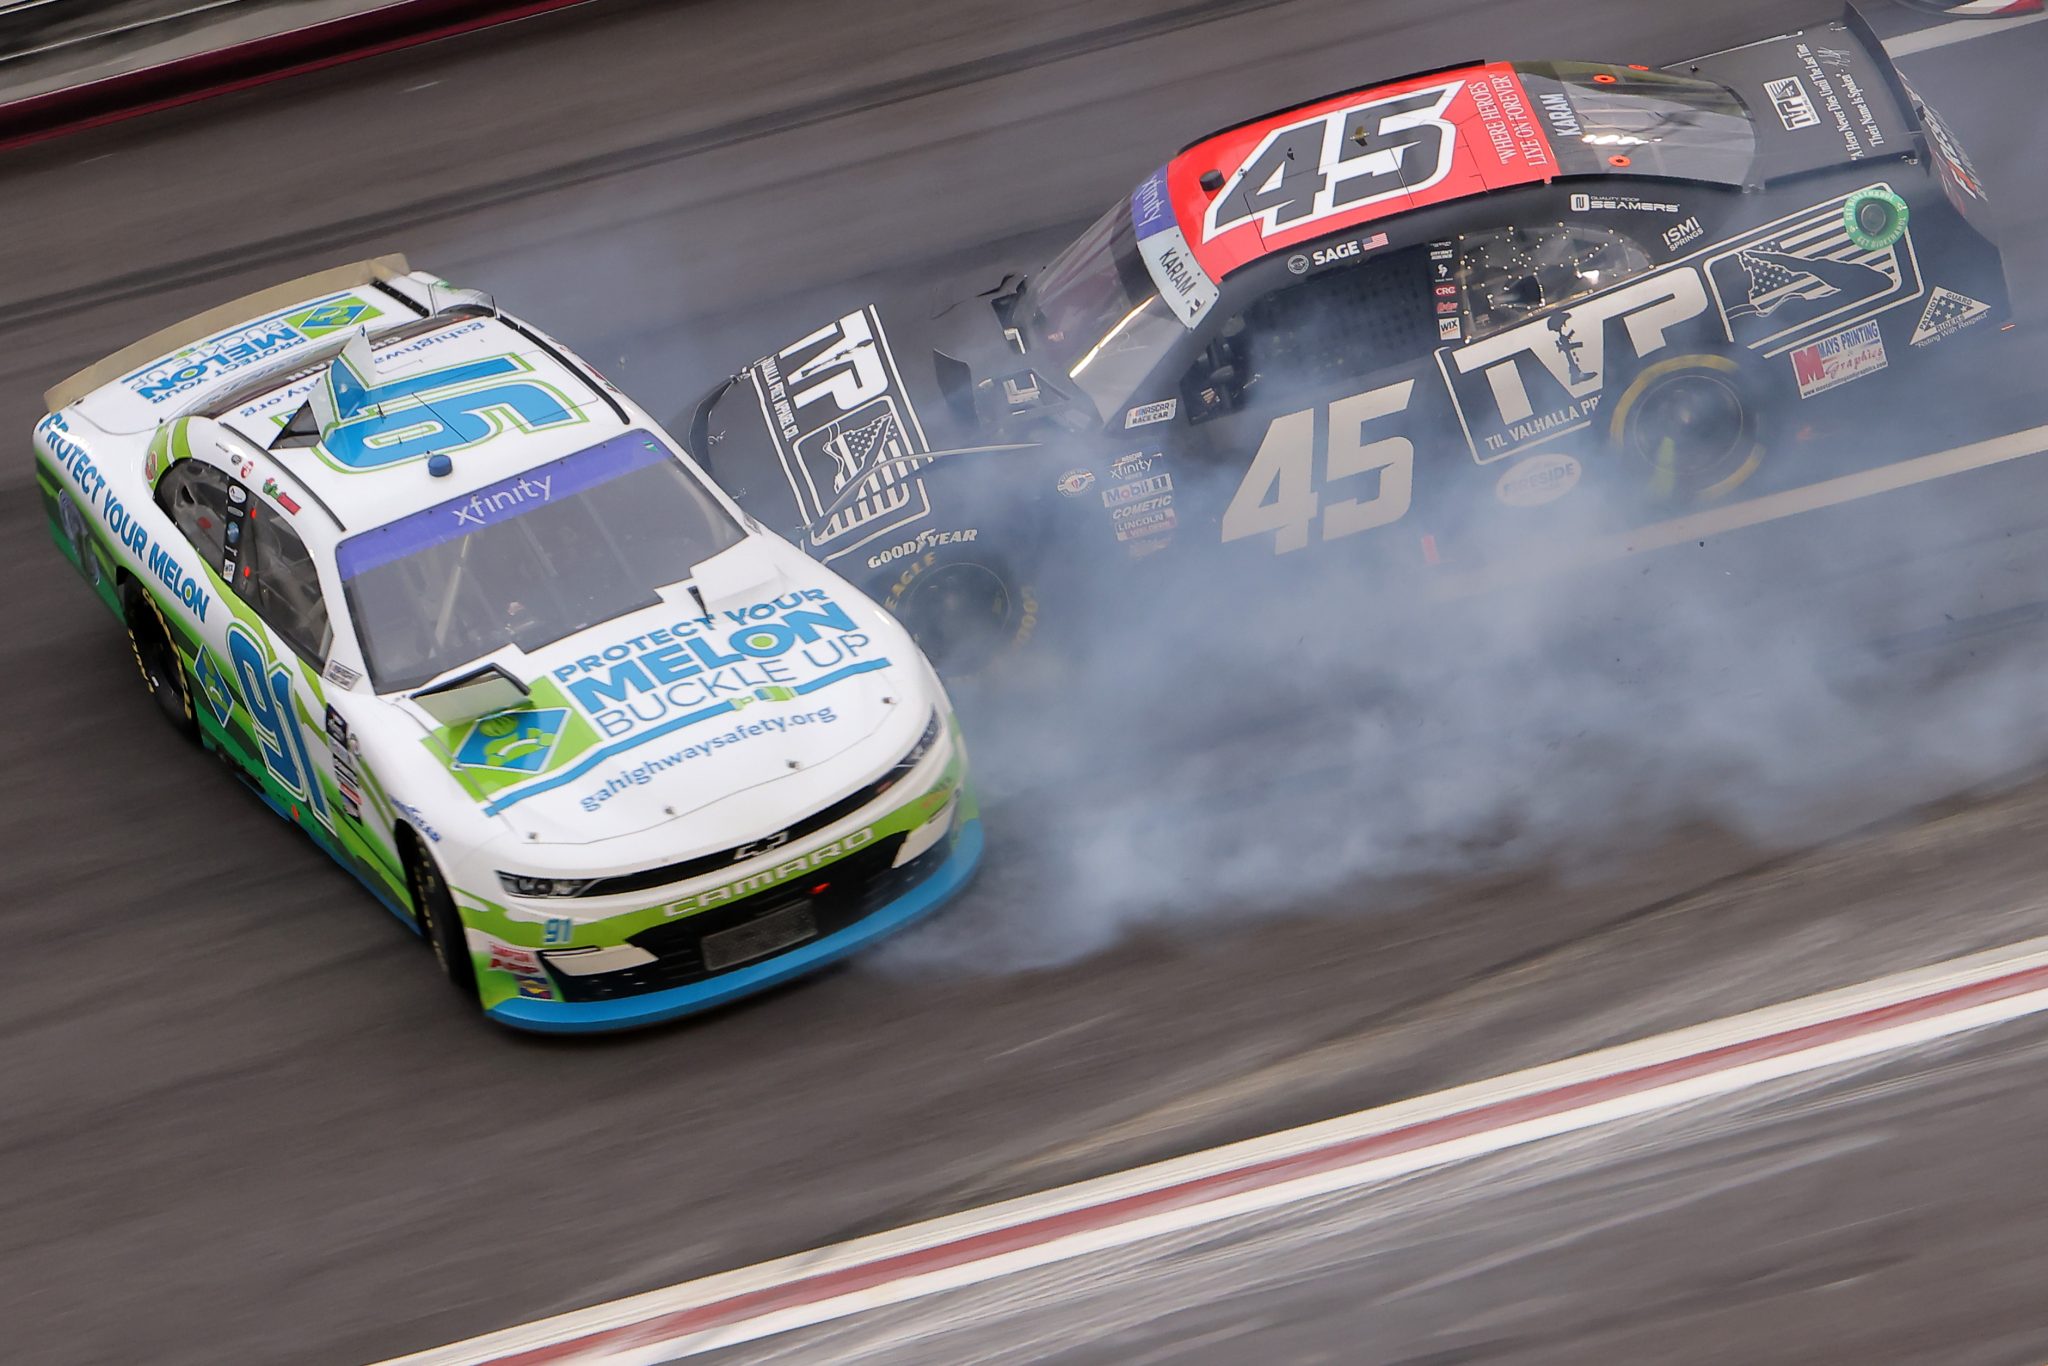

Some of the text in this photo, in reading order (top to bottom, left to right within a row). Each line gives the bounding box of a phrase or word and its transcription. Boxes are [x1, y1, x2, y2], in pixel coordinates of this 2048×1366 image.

[1796, 43, 1811, 58] Time
[1804, 56, 1819, 69] Last
[1809, 67, 1824, 81] The
[1814, 79, 1833, 97] Until
[1468, 81, 1501, 124] HEROES
[1539, 93, 1582, 137] KARAM
[1826, 95, 1841, 112] Dies
[1857, 103, 1875, 125] Name
[1513, 121, 1536, 142] ON
[1834, 111, 1851, 131] Never
[1865, 123, 1884, 147] Their
[1520, 138, 1548, 166] LIVE
[1845, 130, 1861, 151] Hero
[1202, 80, 1466, 245] 45
[1136, 174, 1164, 227] xfinity
[1590, 200, 1679, 213] SEAMERS
[1312, 240, 1361, 266] SAGE
[1669, 228, 1704, 252] SPRINGS
[1159, 247, 1197, 297] KARAM
[1435, 286, 1456, 296] CRC
[1945, 292, 1973, 306] GUARD
[1440, 320, 1459, 332] WIX
[1919, 296, 1939, 331] PATRIOT
[130, 320, 285, 390] BUCKLE UP
[1451, 266, 1709, 426] TVP
[1817, 322, 1880, 360] MAYS PRINTING
[137, 327, 300, 400] MELON
[151, 337, 308, 404] PROTECT YOUR
[1792, 344, 1826, 387] M
[1825, 347, 1884, 379] Graphics
[1132, 411, 1169, 424] RACE CAR
[1485, 434, 1508, 451] TIL
[1508, 405, 1580, 442] VALHALLA
[1110, 459, 1153, 480] xfinity
[1221, 378, 1415, 556] 45
[451, 472, 554, 528] xfinity
[1106, 479, 1149, 504] Mobil
[1112, 495, 1173, 520] COMETIC
[1117, 511, 1165, 532] LINCOLN
[102, 488, 149, 563] YOUR
[148, 541, 210, 624] MELON
[867, 528, 978, 569] GOODYEAR
[553, 583, 831, 684] PROTECT YOUR
[567, 600, 860, 715] MELON
[595, 632, 871, 739] BUCKLE UP
[226, 621, 341, 838] 91
[578, 704, 840, 813] gahighwaysafety.org
[663, 826, 876, 919] CAMARO
[541, 917, 573, 946] 91
